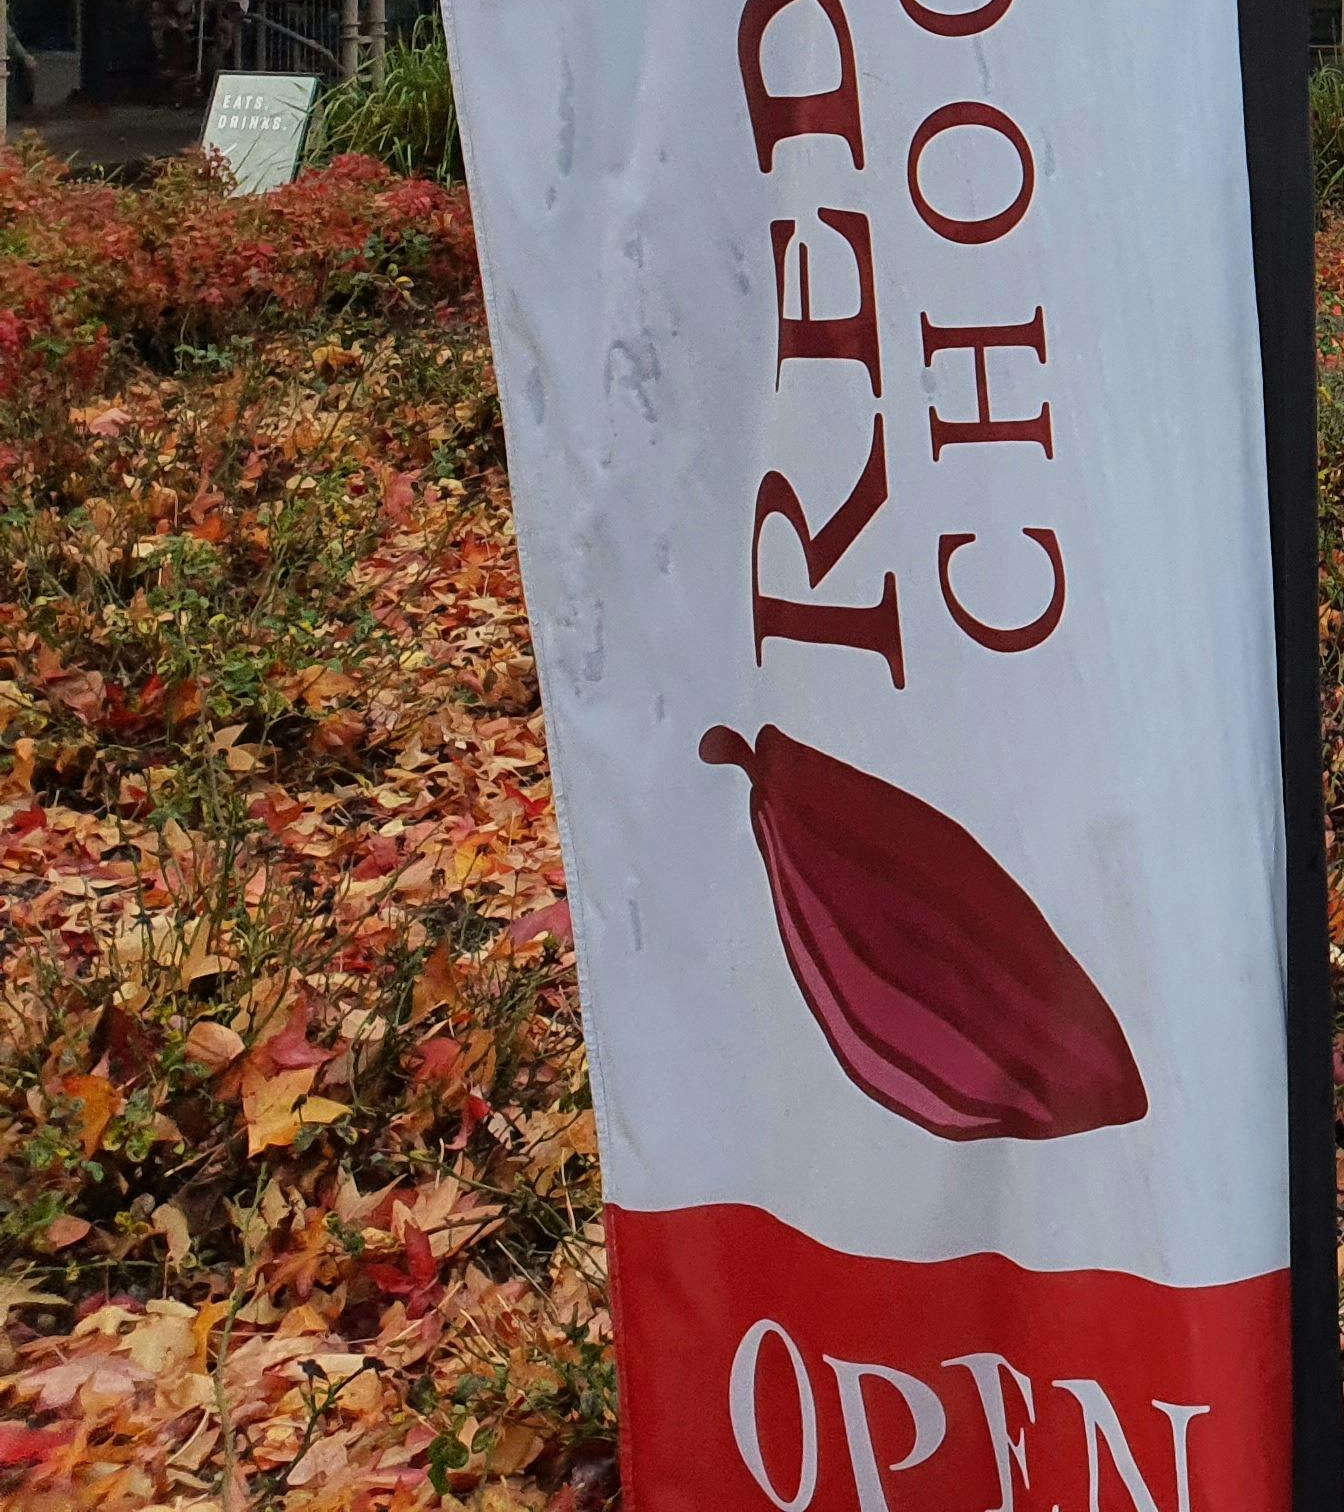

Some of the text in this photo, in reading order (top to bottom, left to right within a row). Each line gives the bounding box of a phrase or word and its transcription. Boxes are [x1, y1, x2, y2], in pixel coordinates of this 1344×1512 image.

[222, 94, 269, 110] EATS.
[217, 114, 287, 131] DRINKS.
[729, 1318, 1211, 1512] OPEN
